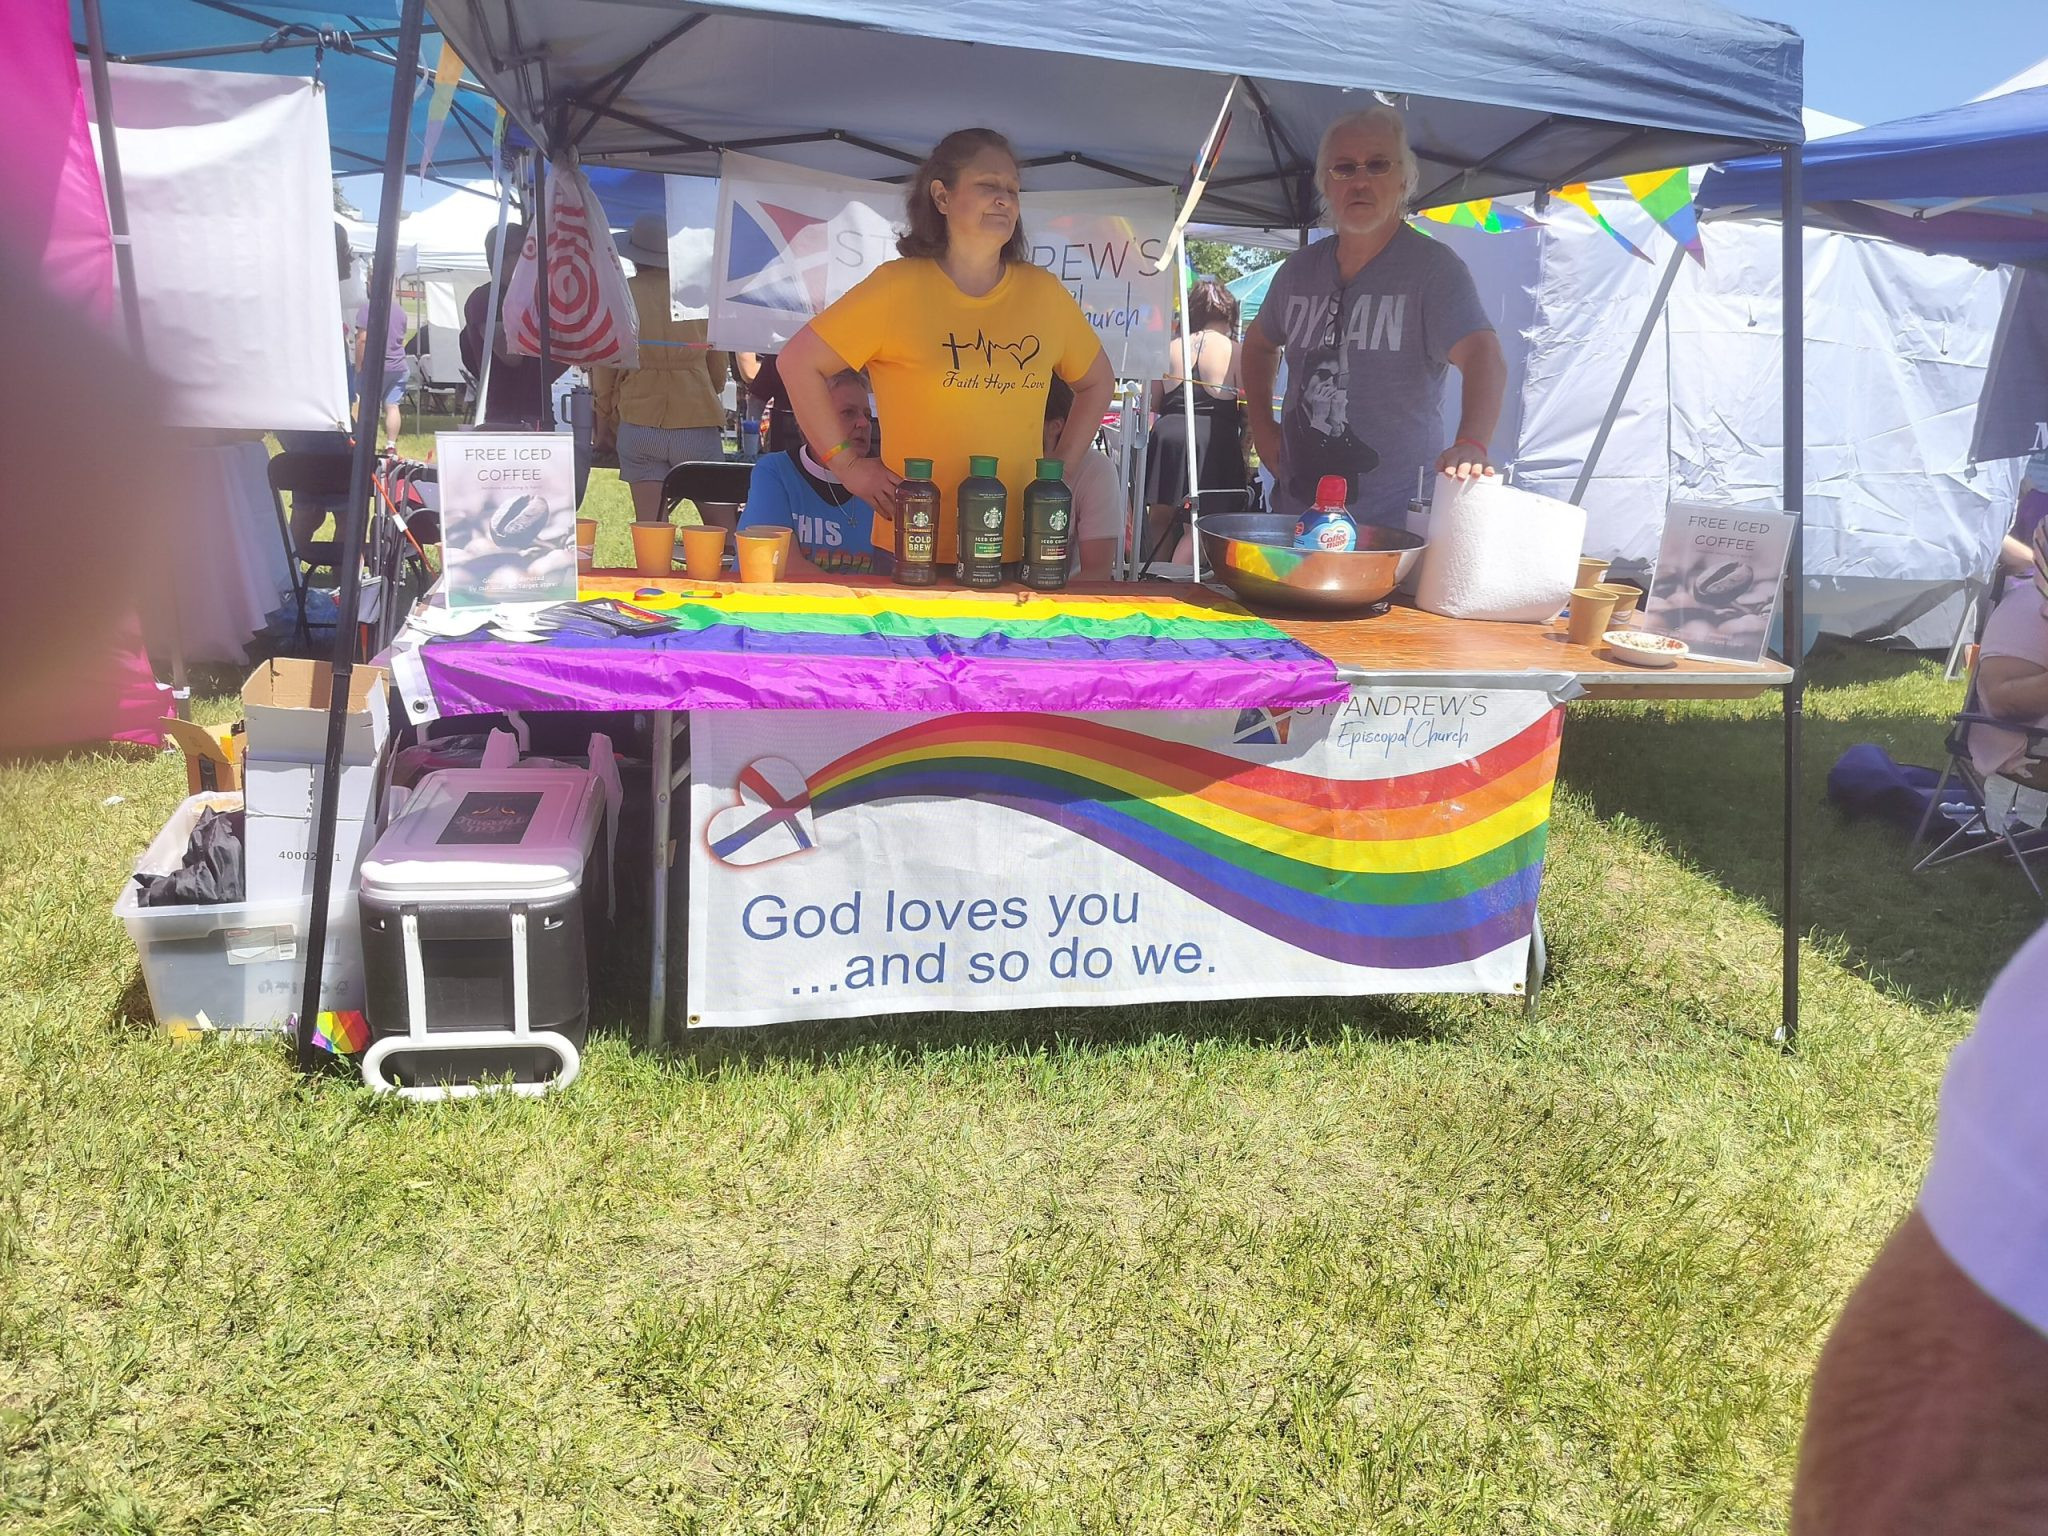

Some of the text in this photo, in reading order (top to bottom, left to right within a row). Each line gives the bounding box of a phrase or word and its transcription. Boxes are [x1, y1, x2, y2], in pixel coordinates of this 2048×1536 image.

[1069, 280, 1140, 338] hurch
[942, 370, 1045, 395] Faith Hope Love
[465, 448, 552, 461] FREE ICED
[477, 468, 543, 482] COFFEE
[1688, 515, 1770, 535] FREE ICED
[908, 535, 932, 544] COLD
[1320, 532, 1347, 544] Coffee
[1694, 534, 1756, 551] COFFEE
[908, 543, 932, 552] BREW
[1342, 694, 1489, 717] ANDREW'S
[1336, 717, 1470, 759] Episcopal Church
[278, 850, 342, 862] 400021
[741, 889, 1139, 941] God loves you
[791, 936, 1216, 995] ...and so do we.
